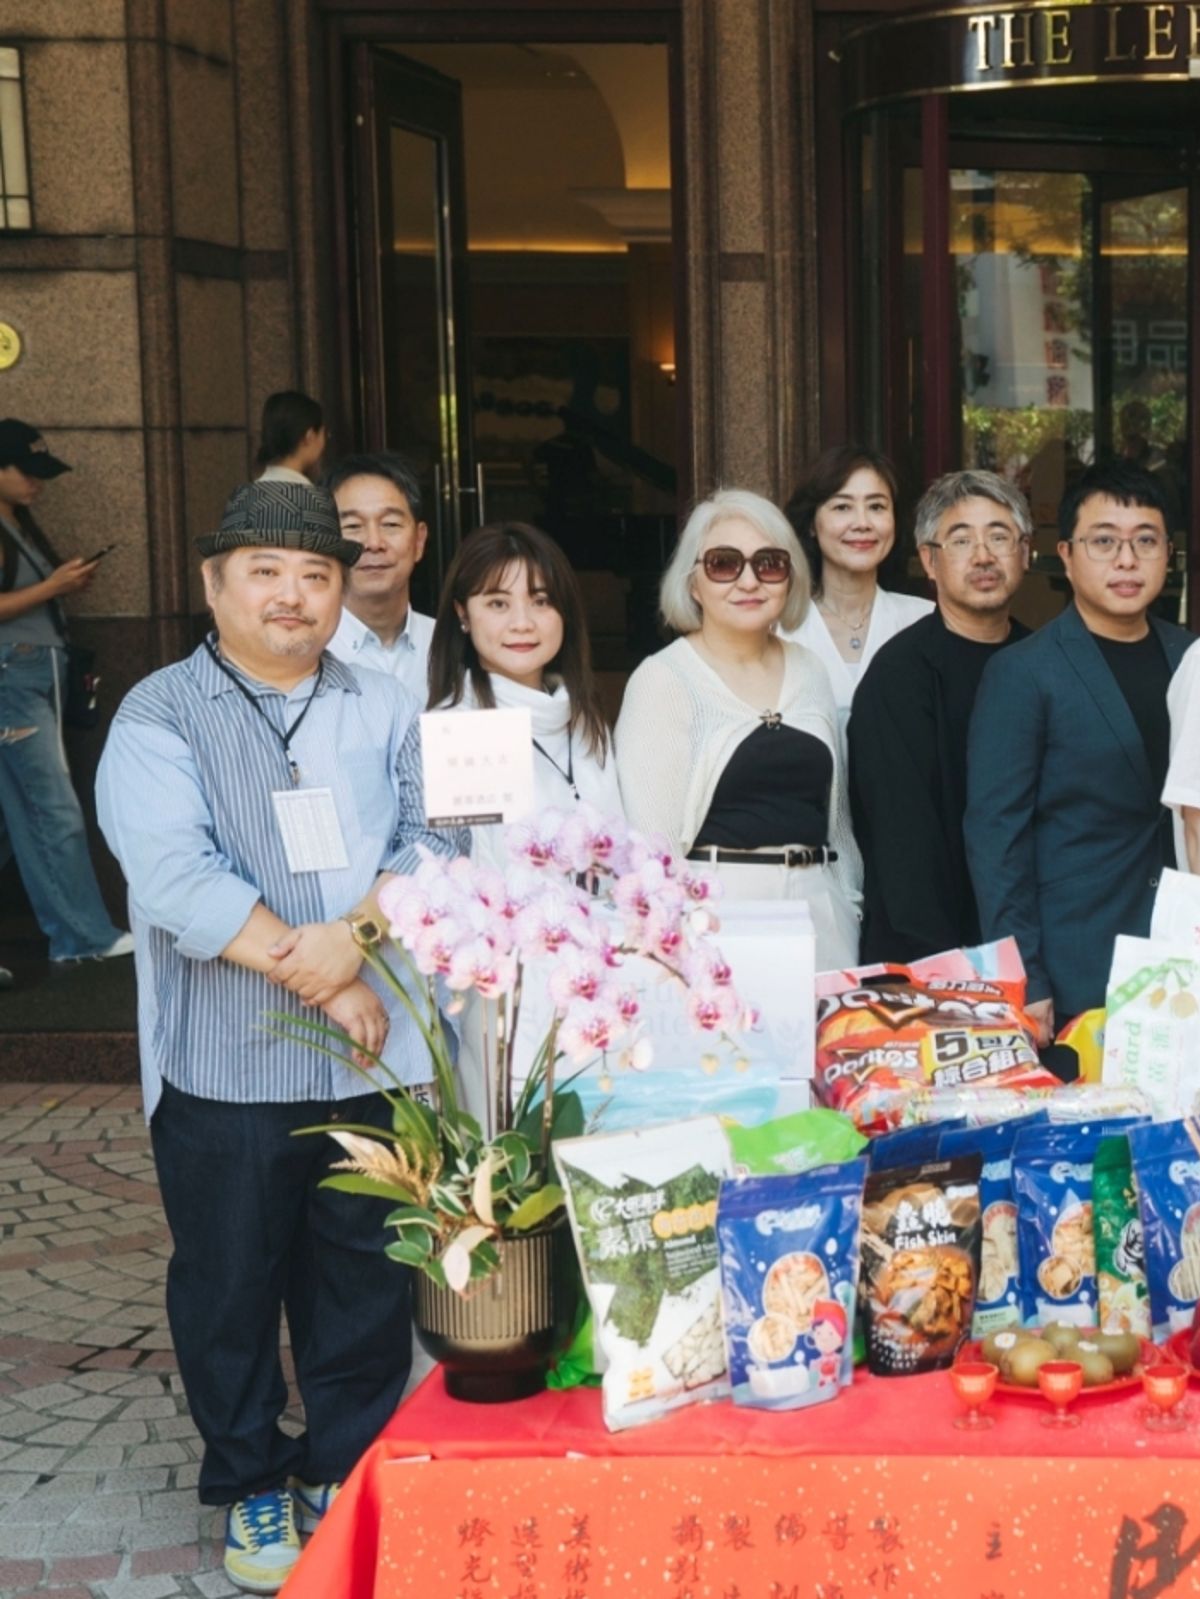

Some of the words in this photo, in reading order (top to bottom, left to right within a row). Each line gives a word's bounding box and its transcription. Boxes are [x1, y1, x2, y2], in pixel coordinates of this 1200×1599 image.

[968, 11, 1074, 71] THE
[824, 1047, 919, 1084] Doritos
[895, 1233, 926, 1251] Fish
[927, 1229, 957, 1246] Skin
